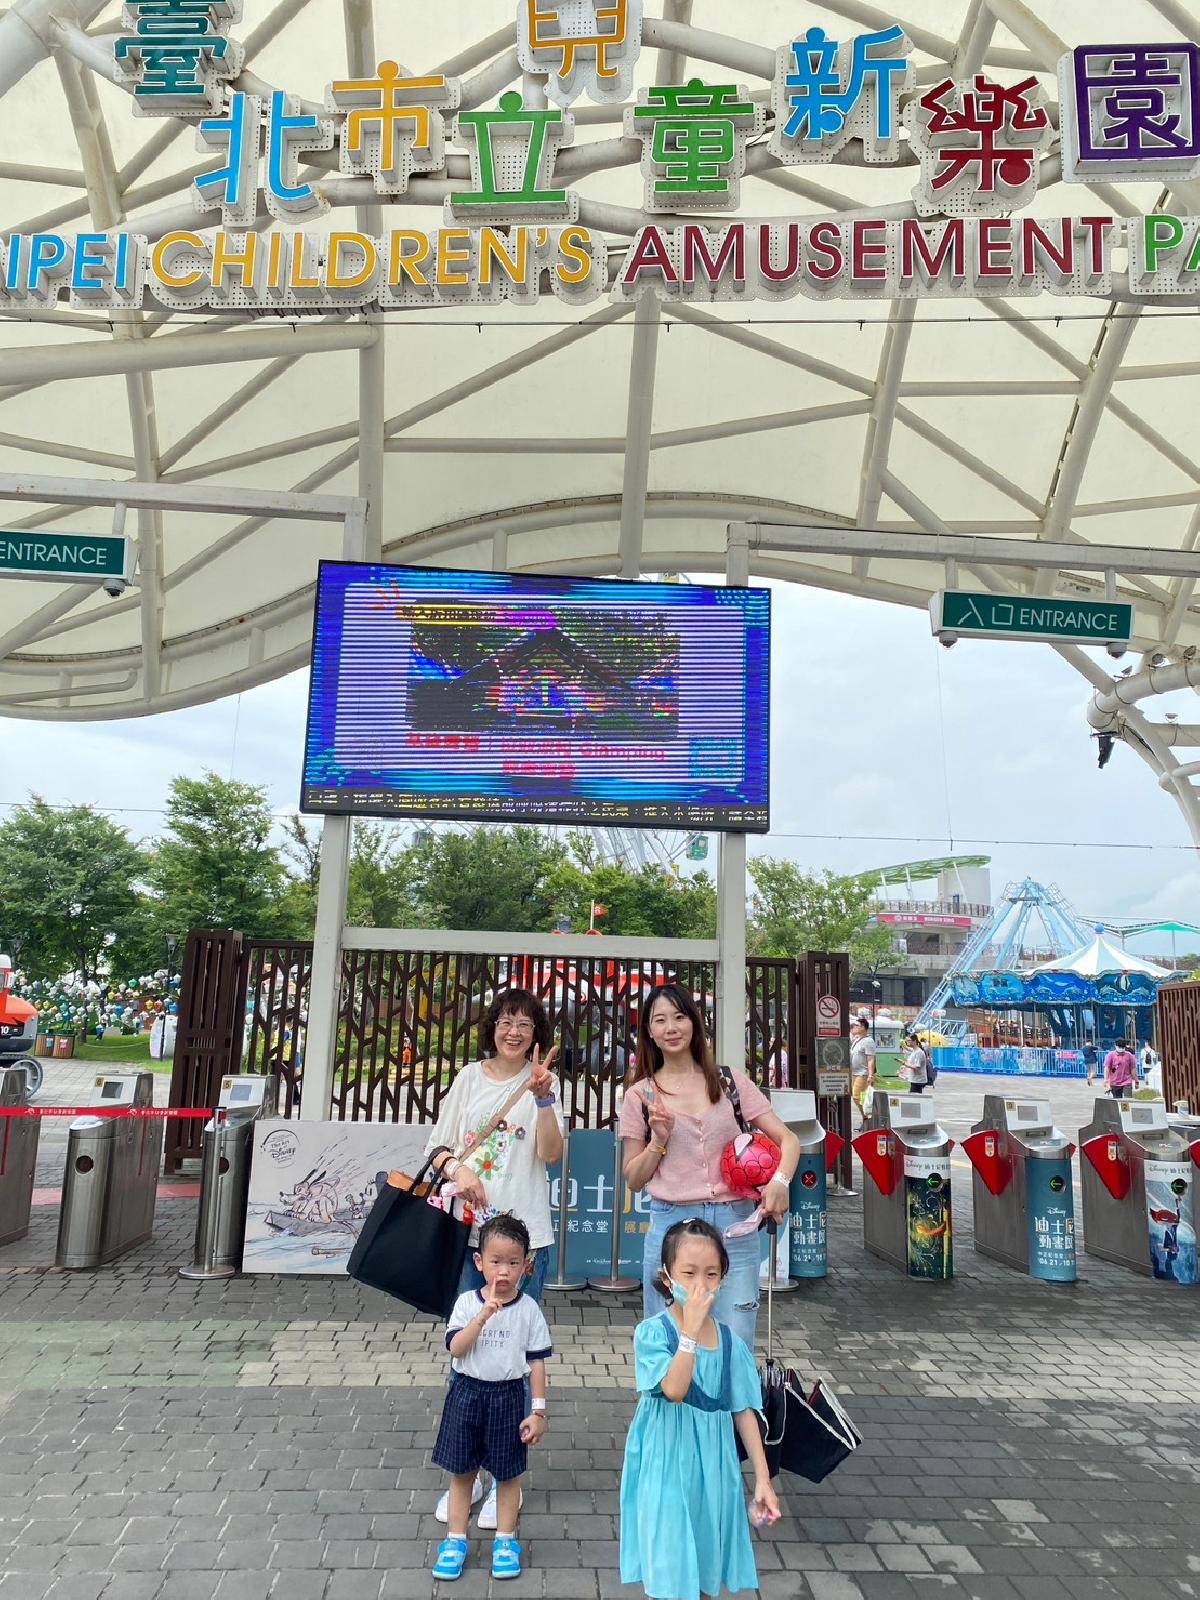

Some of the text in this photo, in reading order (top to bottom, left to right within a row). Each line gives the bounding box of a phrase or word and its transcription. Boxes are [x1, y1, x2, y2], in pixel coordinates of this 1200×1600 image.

[151, 225, 593, 289] CHILDREN'S
[622, 215, 1114, 284] AMUSEMENT
[1144, 213, 1200, 275] P
[956, 597, 1118, 631] 入口 ENTRANCE
